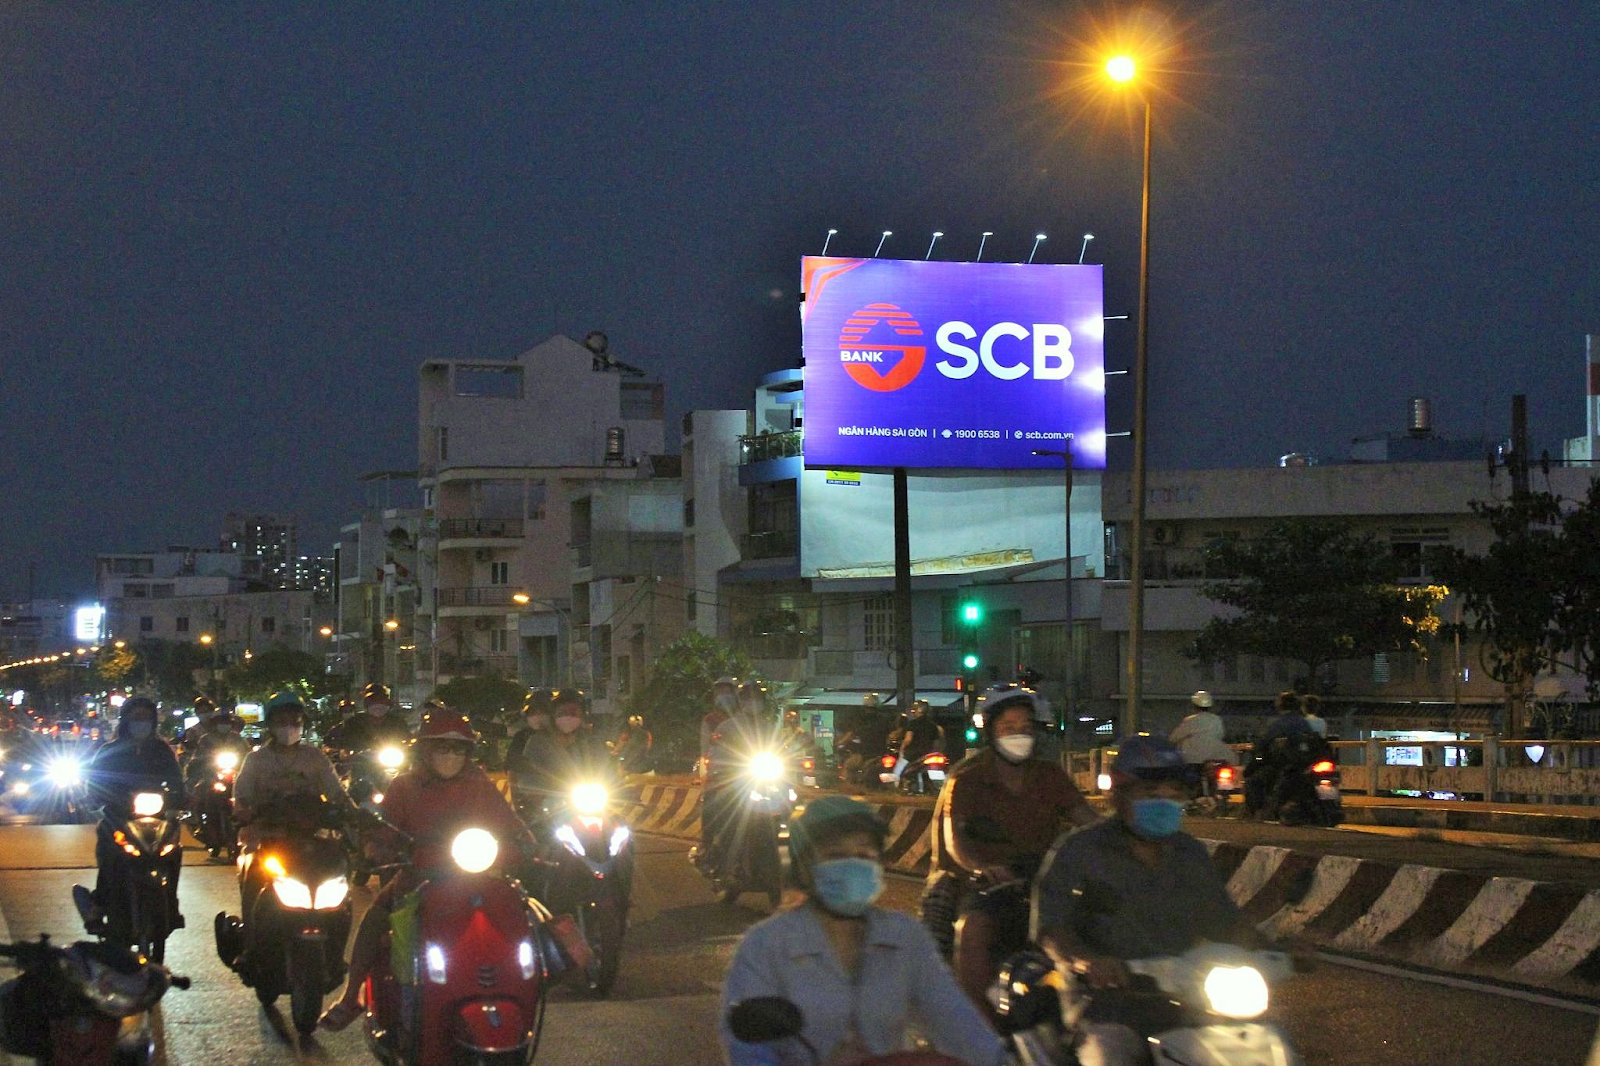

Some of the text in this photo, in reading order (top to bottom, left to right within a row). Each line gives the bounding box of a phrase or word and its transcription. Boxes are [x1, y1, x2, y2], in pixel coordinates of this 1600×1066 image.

[840, 350, 883, 363] BANK
[935, 320, 1075, 381] SCB
[838, 425, 1074, 440] NGÂN HÀNG SÀI GÒN 1900 6538 scb.com.vn
